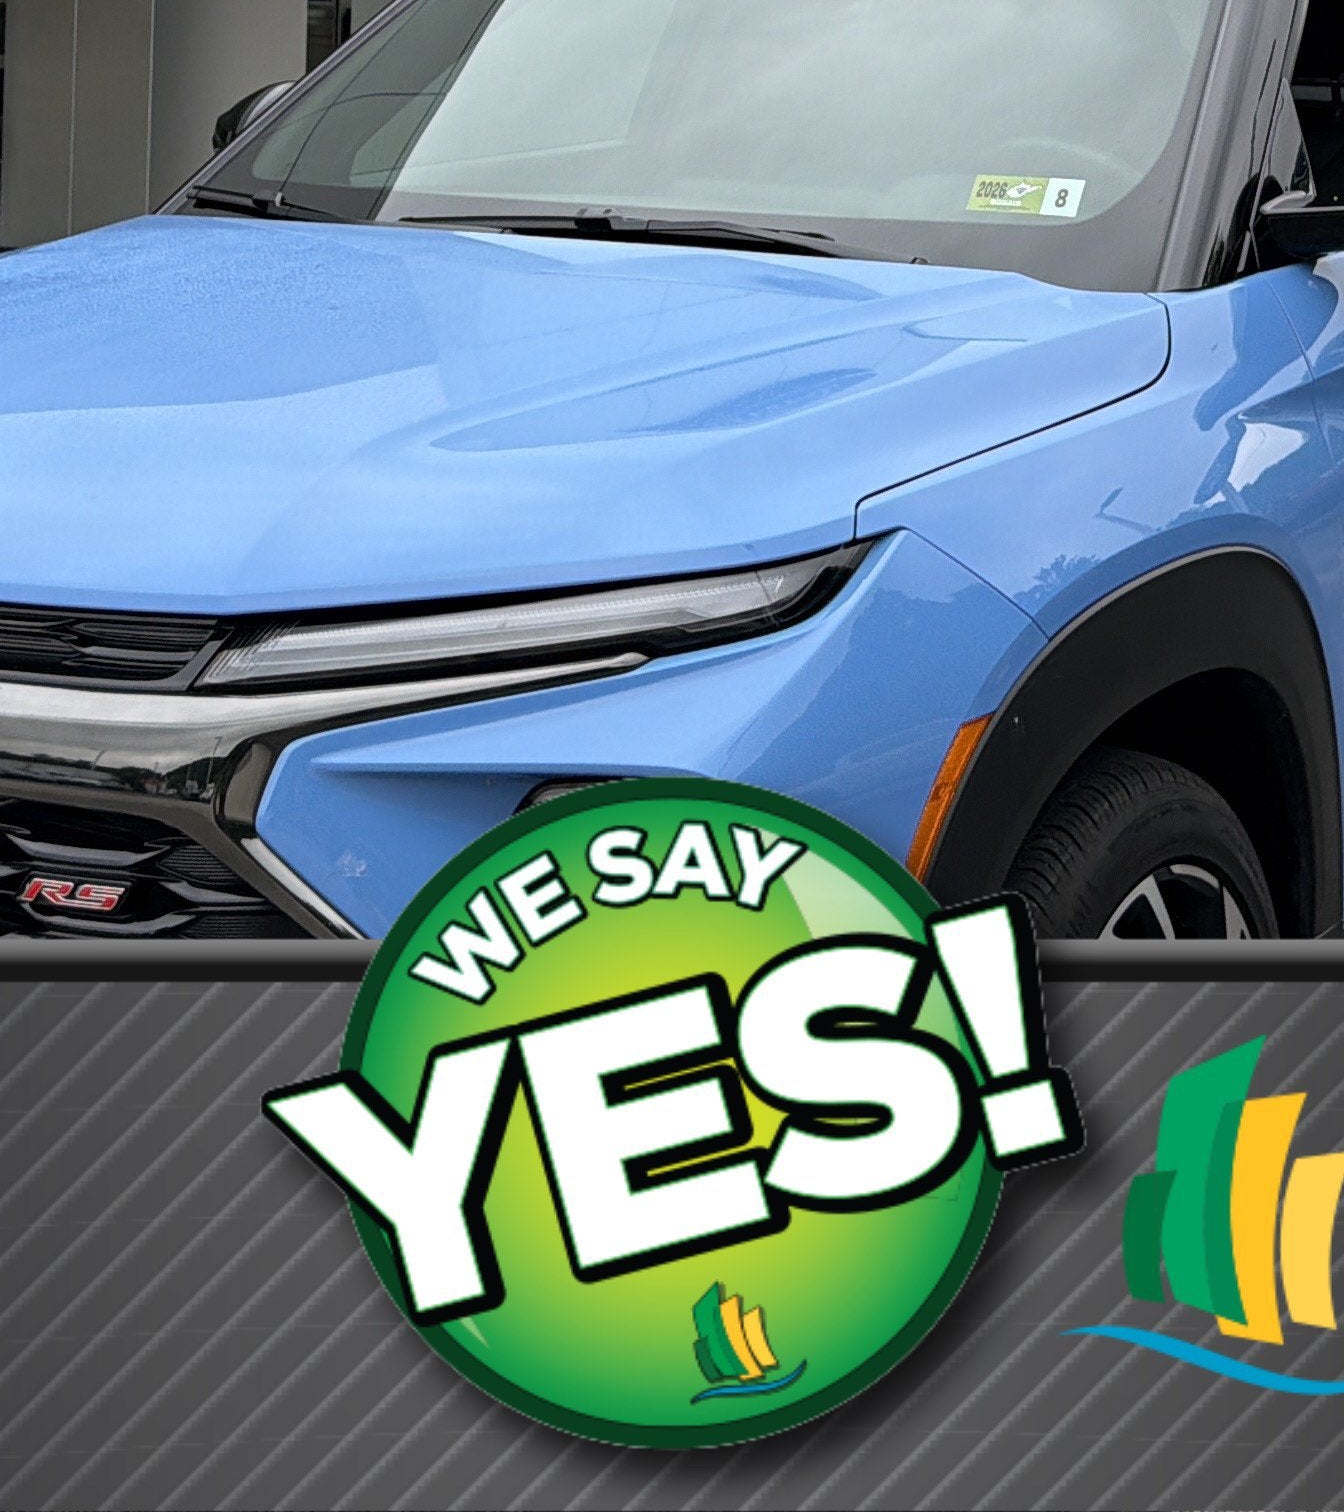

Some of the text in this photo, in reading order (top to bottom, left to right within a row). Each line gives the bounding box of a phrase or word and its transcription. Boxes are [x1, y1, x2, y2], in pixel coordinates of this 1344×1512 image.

[976, 180, 1008, 199] 2026
[1054, 188, 1069, 208] 8
[22, 878, 126, 912] RS
